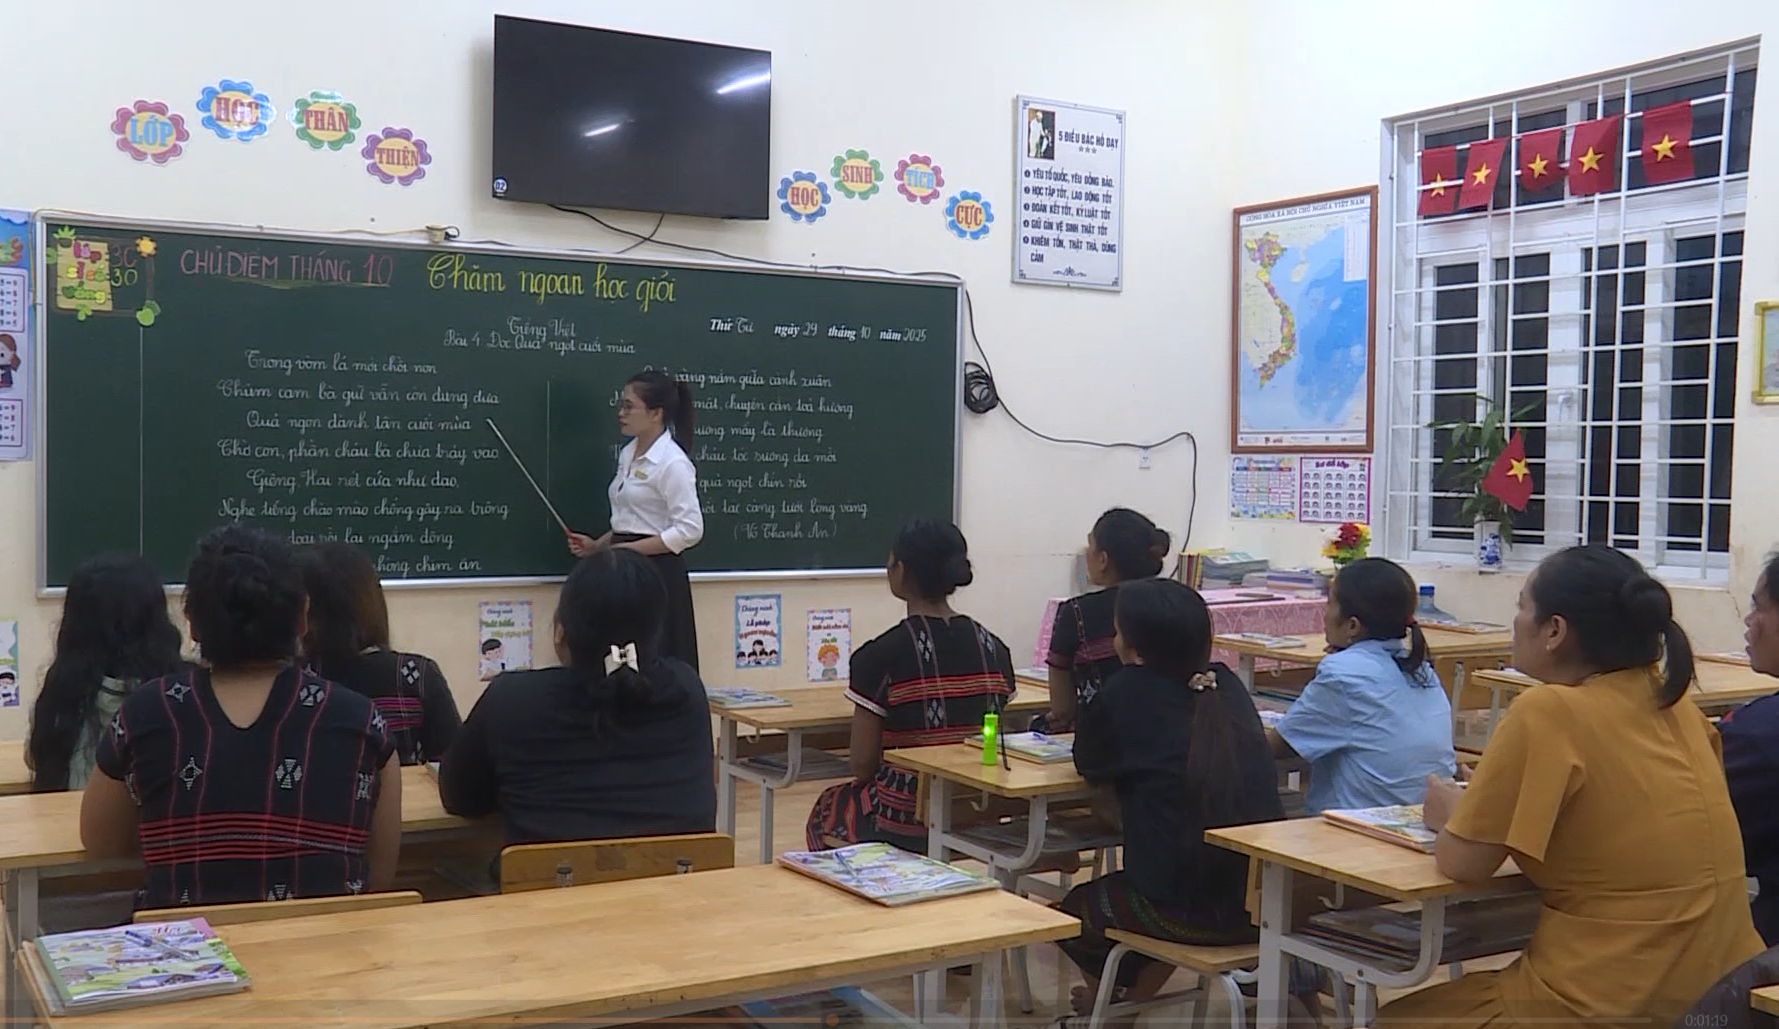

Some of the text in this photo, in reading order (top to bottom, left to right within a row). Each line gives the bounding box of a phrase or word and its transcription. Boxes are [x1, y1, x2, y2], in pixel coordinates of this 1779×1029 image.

[130, 96, 420, 169] LỚP HỌC THÂN THIỆN
[1058, 130, 1063, 142] 5
[1081, 131, 1095, 146] BÁC
[1106, 138, 1119, 150] DẠY
[1071, 172, 1082, 184] YÊU
[790, 164, 983, 229] HỌC SINH TÍCH CỰC
[1032, 186, 1044, 199] HỌC
[1045, 187, 1056, 200] TẬP
[1071, 191, 1082, 201] LAO
[1102, 189, 1112, 204] TỐT
[1049, 200, 1060, 215] KẾT
[1084, 207, 1098, 221] LUẬT
[1100, 206, 1111, 220] TỐT
[1055, 220, 1063, 233] VỆ
[1065, 222, 1079, 233] SINH
[1081, 223, 1096, 237] THẬT
[1098, 221, 1108, 236] TỐT
[1069, 239, 1083, 252] THẬT
[1030, 249, 1044, 263] CẢM
[111, 268, 138, 287] 30
[289, 249, 352, 283] THÁNG
[363, 253, 394, 286] 10
[427, 252, 676, 313] Chăm ngoan học giỏi
[710, 318, 734, 332] Thứ
[774, 322, 800, 338] ngày
[802, 322, 818, 337] 29
[827, 324, 857, 341] tháng
[860, 324, 871, 340] 10
[879, 327, 902, 342] năm
[902, 327, 928, 342] 2025
[245, 350, 293, 376] Trong
[332, 352, 349, 371] lá
[413, 363, 437, 374] non
[217, 379, 272, 398] Chùm
[278, 388, 309, 399] cam
[246, 410, 280, 428] Quả
[287, 418, 322, 435] ngon
[438, 415, 471, 430] mùa
[254, 446, 285, 460] con,
[335, 440, 369, 458] cháu
[300, 468, 332, 487] Hai
[218, 498, 256, 523] Nghe
[415, 554, 453, 572] chim
